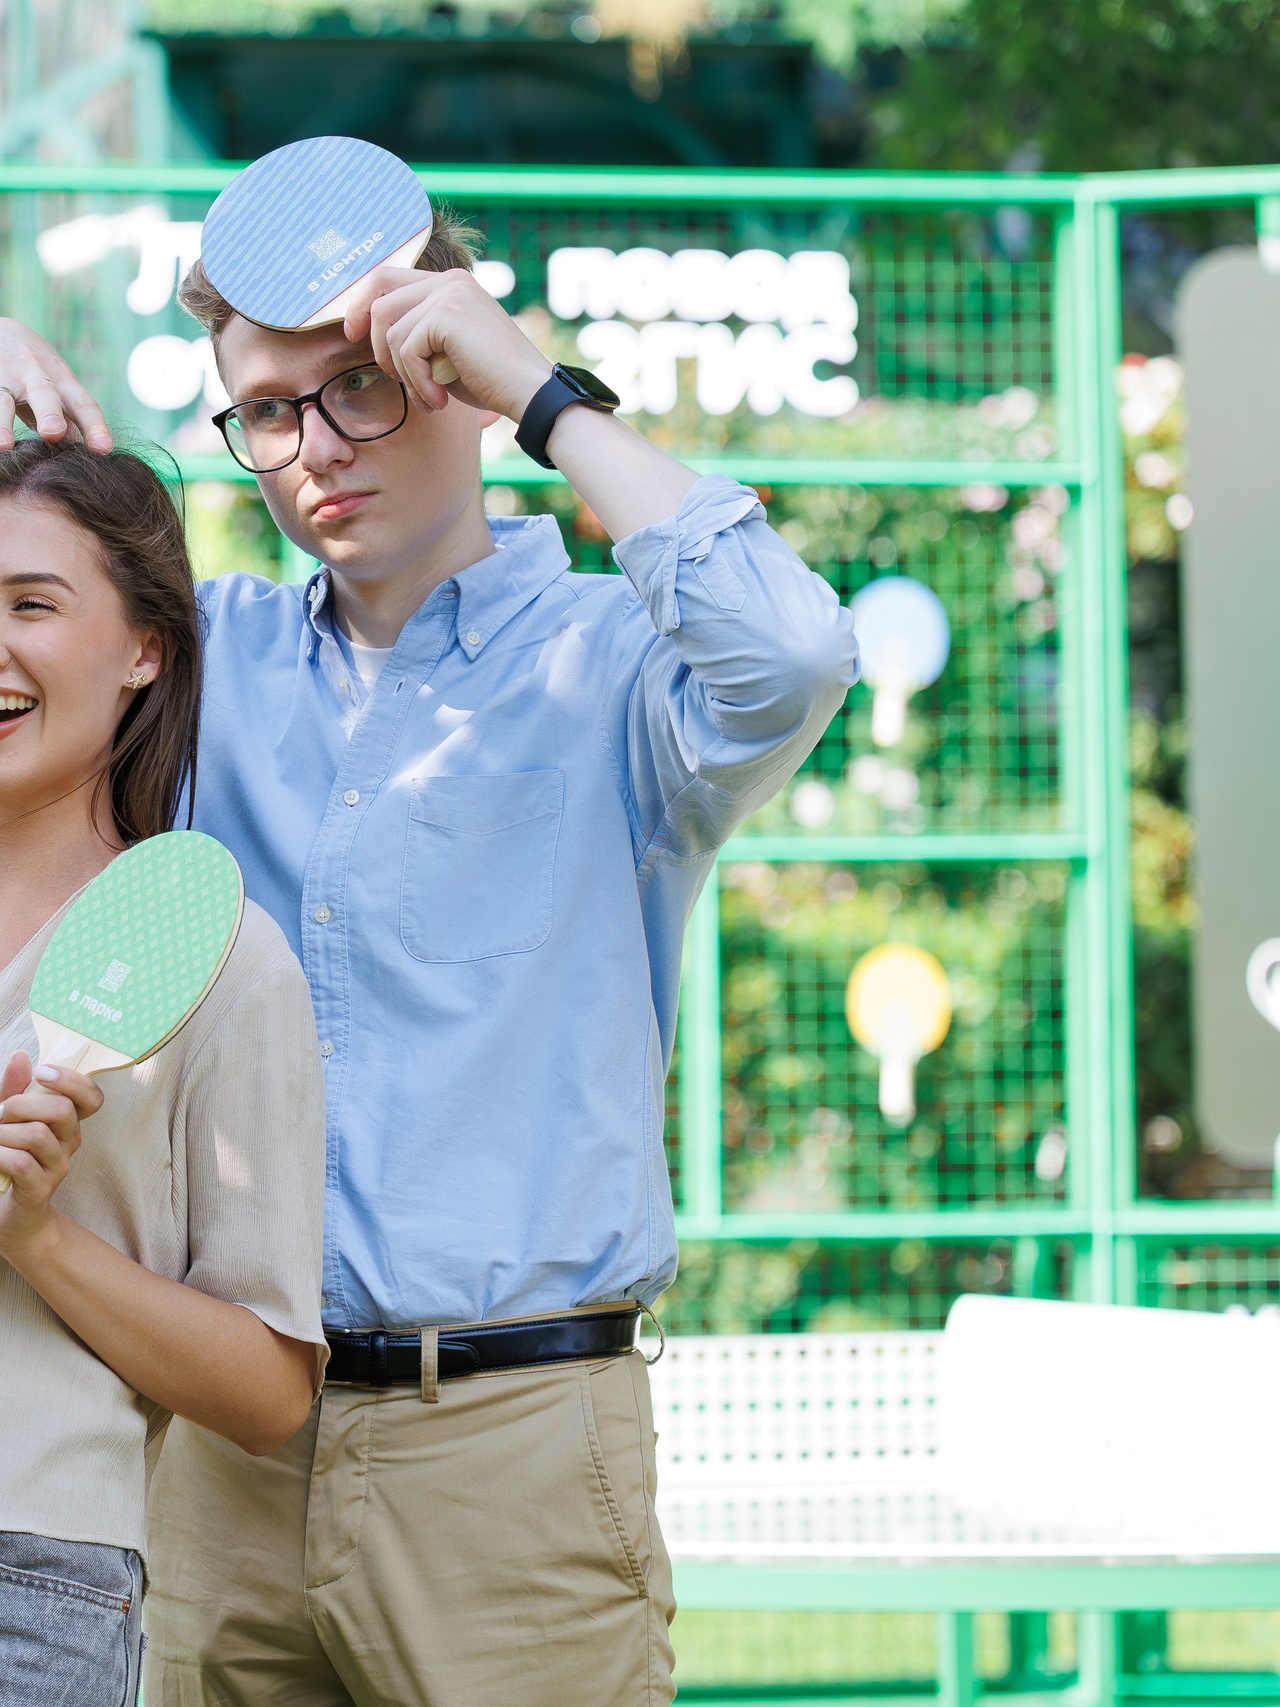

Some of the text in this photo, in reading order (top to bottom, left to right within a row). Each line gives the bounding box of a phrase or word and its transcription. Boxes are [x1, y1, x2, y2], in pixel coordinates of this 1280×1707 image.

[307, 232, 384, 292] в центре
[69, 990, 122, 1022] в парке
